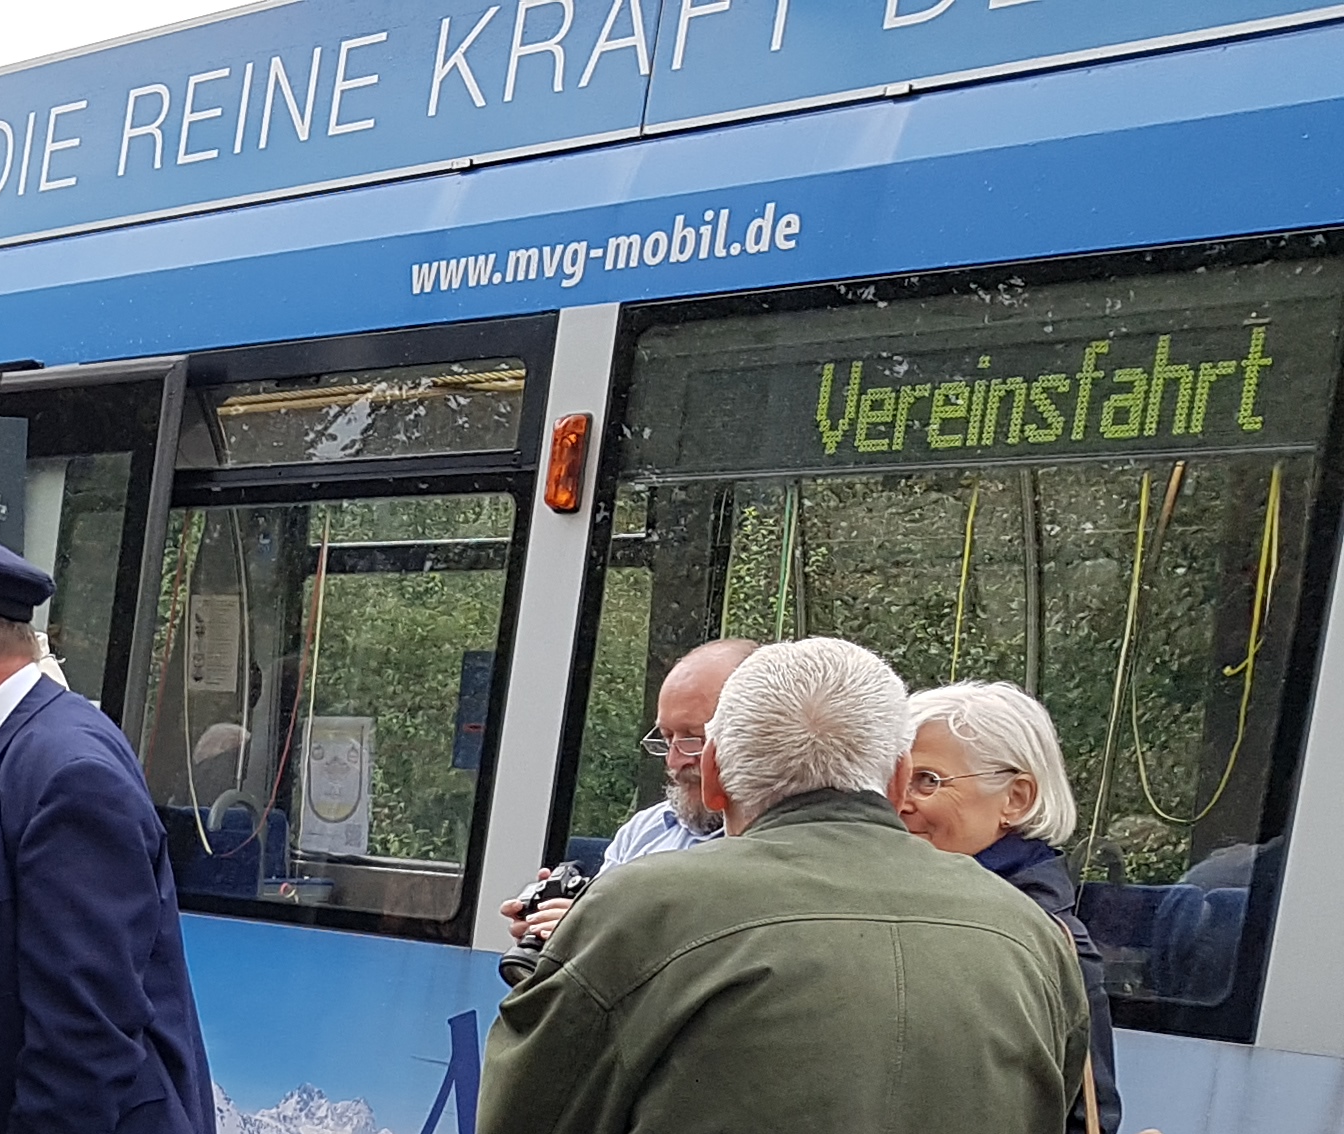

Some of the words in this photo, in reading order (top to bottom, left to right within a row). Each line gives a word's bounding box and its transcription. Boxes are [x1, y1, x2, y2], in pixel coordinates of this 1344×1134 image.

[116, 32, 388, 176] REINE
[411, 201, 802, 294] www.mvg-mobil.de
[816, 325, 1273, 454] Vereinsfahrt
